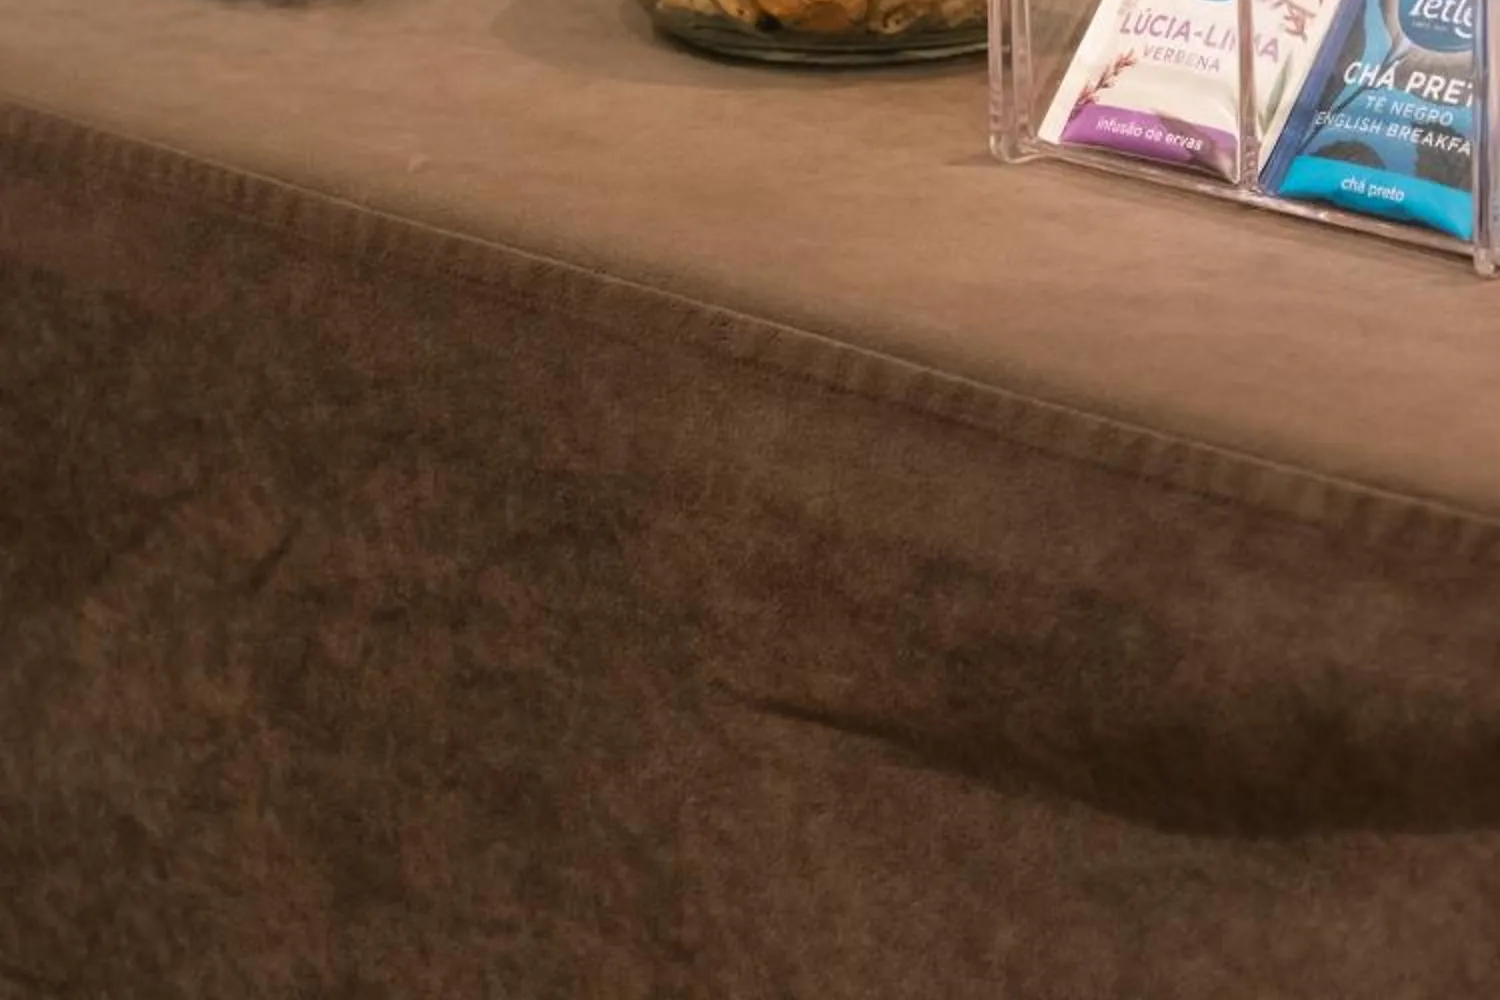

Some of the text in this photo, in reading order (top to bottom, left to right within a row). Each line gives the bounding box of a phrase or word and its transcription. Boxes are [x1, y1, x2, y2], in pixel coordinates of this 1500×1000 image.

[1343, 59, 1400, 91] CHÁ
[1390, 101, 1454, 127] NEGRO
[1165, 133, 1204, 152] ervas
[1315, 111, 1472, 158] ENGLISH BREAKFA
[1367, 184, 1405, 203] preto
